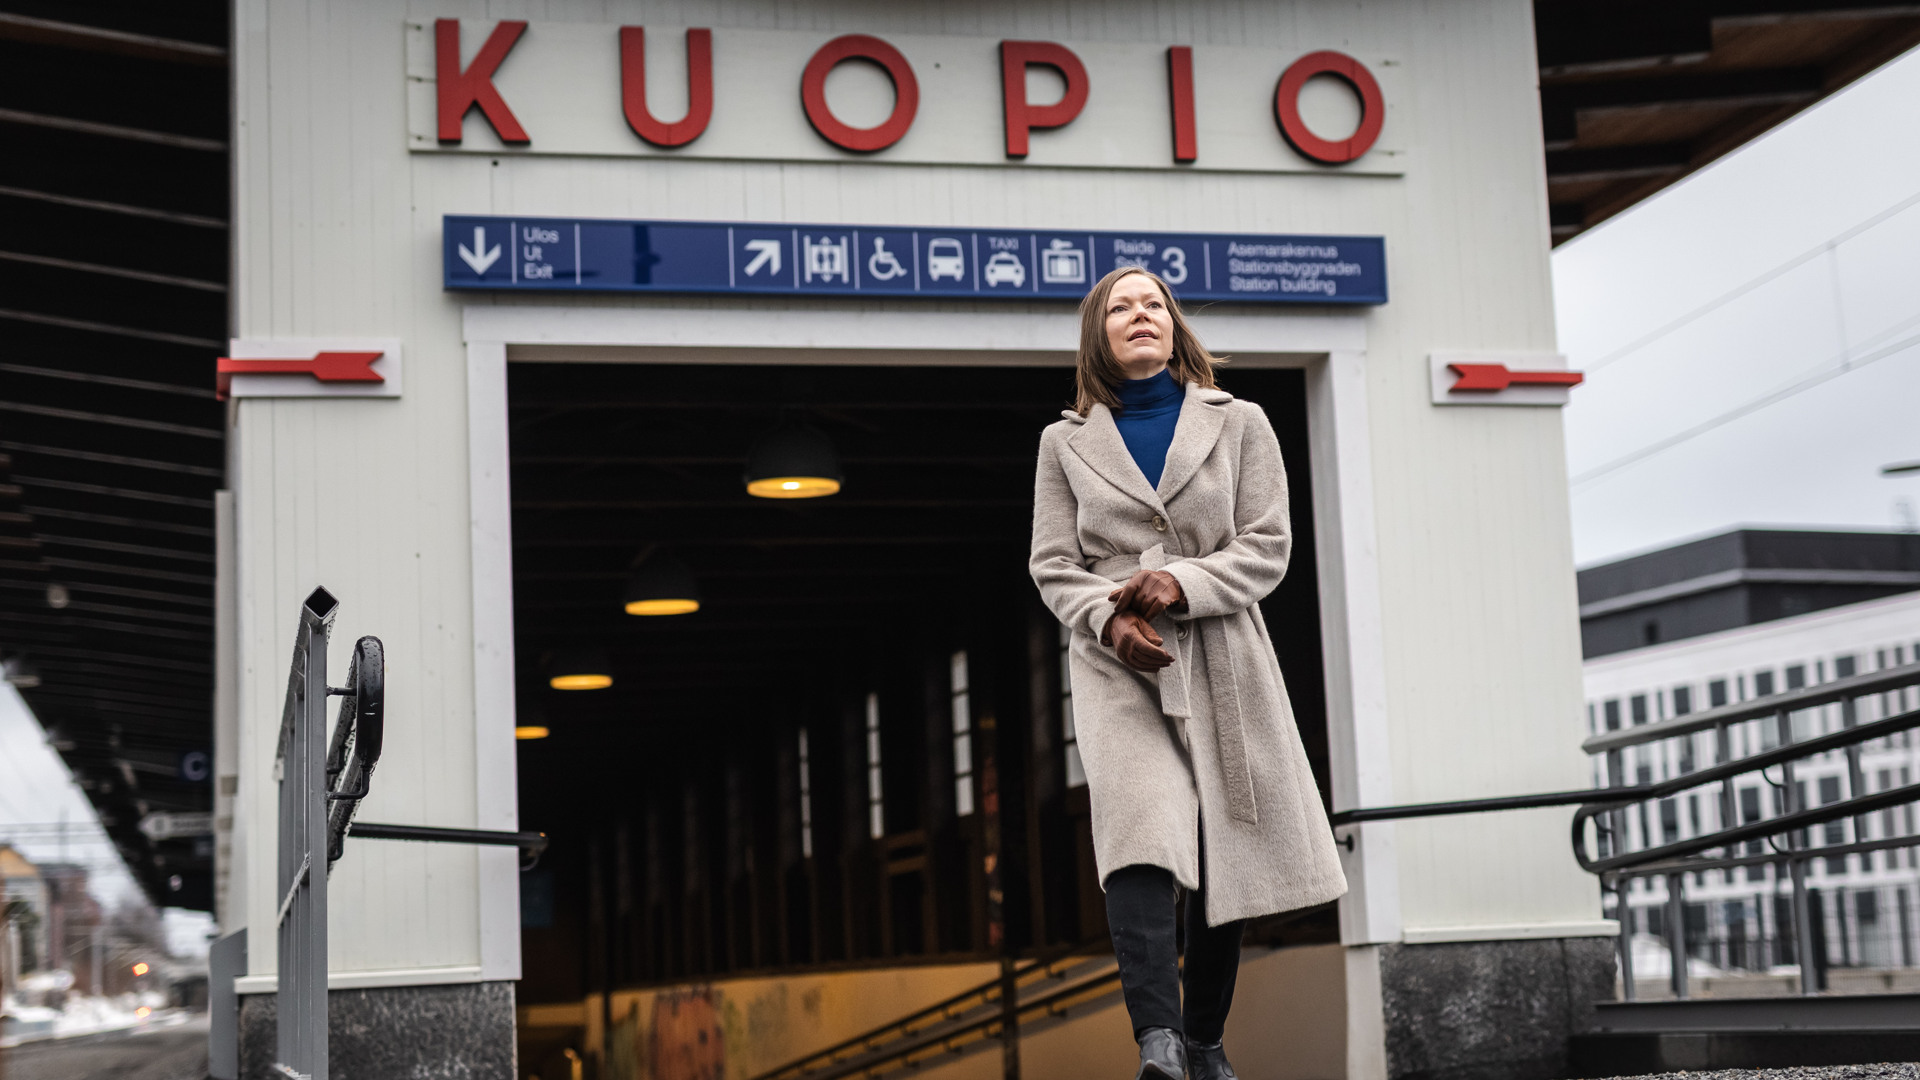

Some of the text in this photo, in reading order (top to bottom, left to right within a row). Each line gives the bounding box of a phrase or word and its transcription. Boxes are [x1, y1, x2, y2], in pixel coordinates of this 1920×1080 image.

[434, 18, 1386, 163] KUOPIO
[523, 227, 559, 243] Ulos
[989, 237, 1019, 249] TAXI
[523, 245, 543, 261] Ut
[1114, 239, 1155, 255] Raide
[1228, 241, 1338, 258] Asemarakennus
[524, 263, 553, 279] Exit
[1162, 246, 1188, 285] 3
[1229, 259, 1361, 277] Stationsbyggnaden
[1230, 276, 1336, 296] Station building
